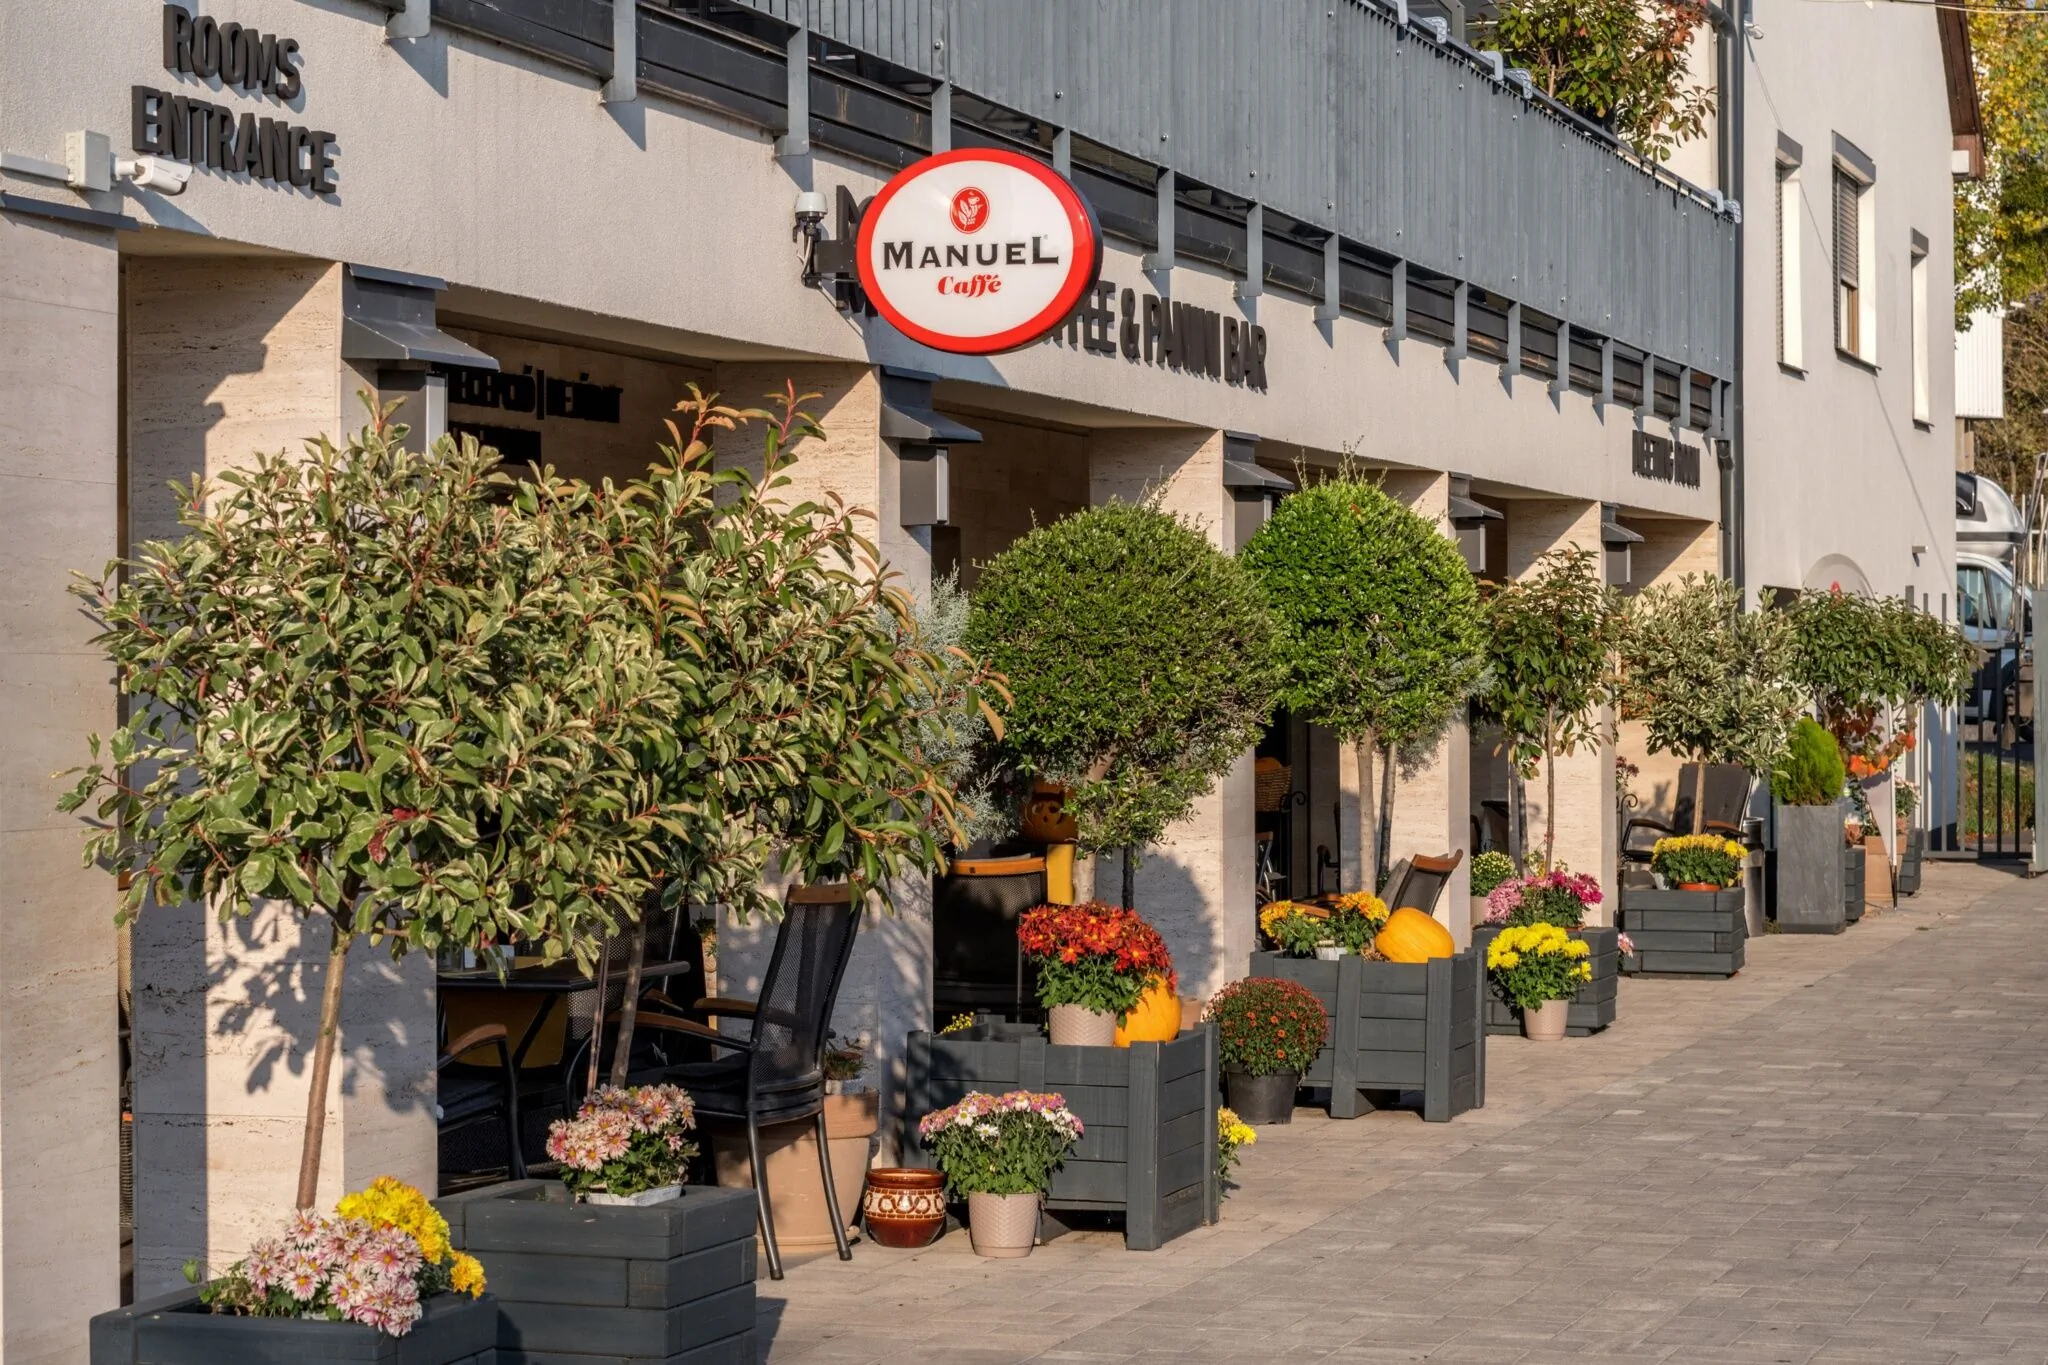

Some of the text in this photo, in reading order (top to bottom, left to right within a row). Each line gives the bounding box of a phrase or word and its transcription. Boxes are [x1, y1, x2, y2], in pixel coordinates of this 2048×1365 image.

[163, 4, 300, 100] ROOMS
[131, 85, 336, 194] ENTRANCE
[883, 236, 1059, 270] MANUEL
[937, 274, 1001, 298] Caffé
[1119, 287, 1141, 359] &
[1223, 316, 1268, 390] BAR
